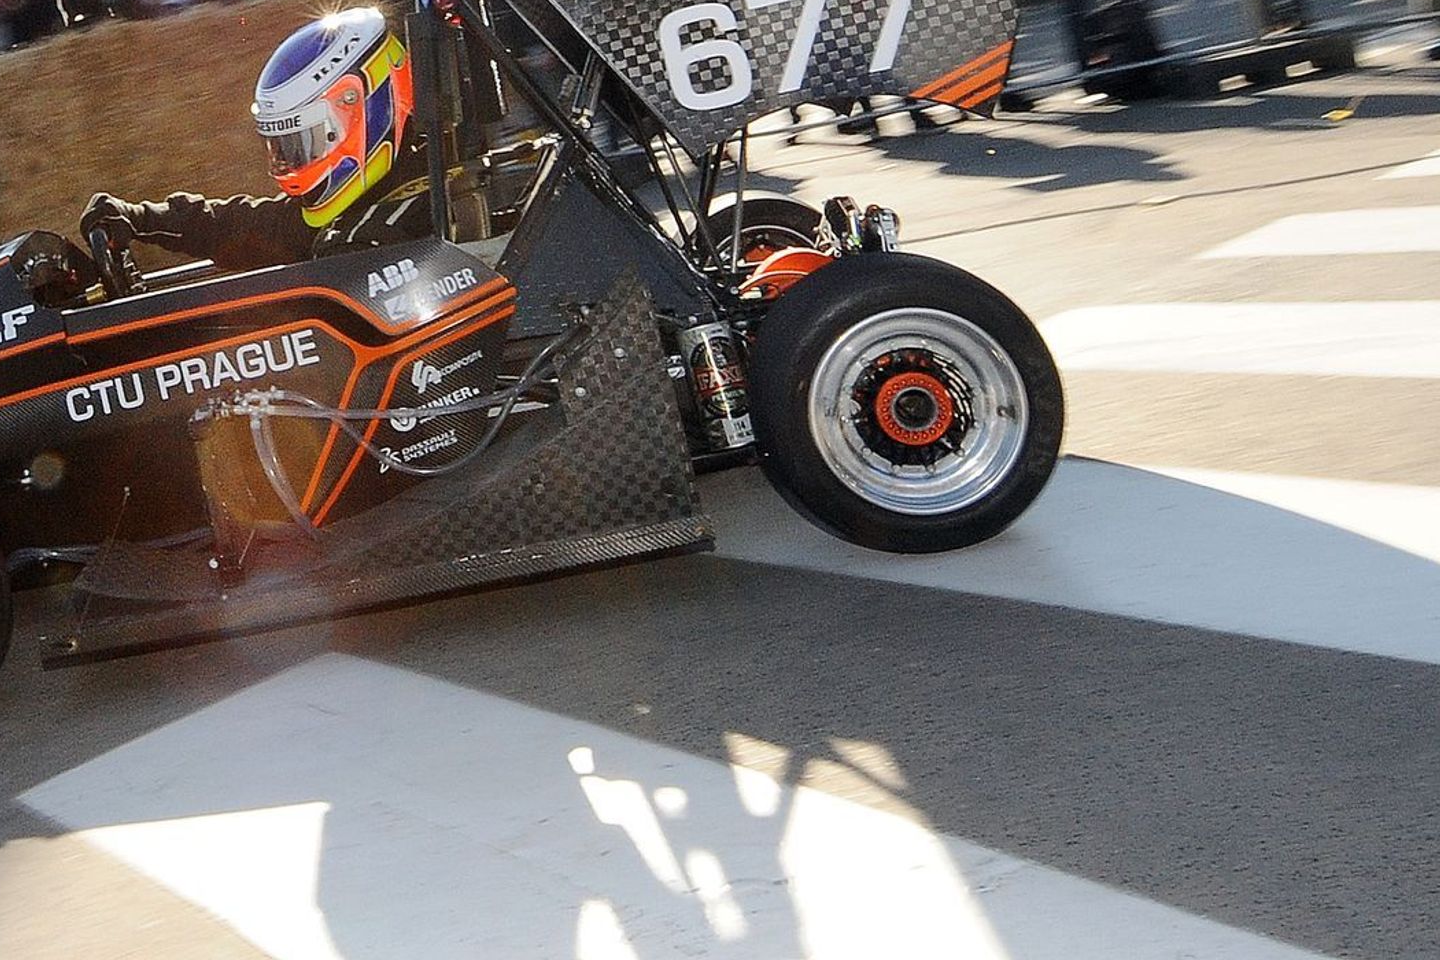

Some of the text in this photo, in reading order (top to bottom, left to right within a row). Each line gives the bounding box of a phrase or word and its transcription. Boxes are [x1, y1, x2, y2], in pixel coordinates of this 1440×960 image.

[367, 258, 420, 298] ABB
[66, 329, 321, 423] CTU PRAGUE
